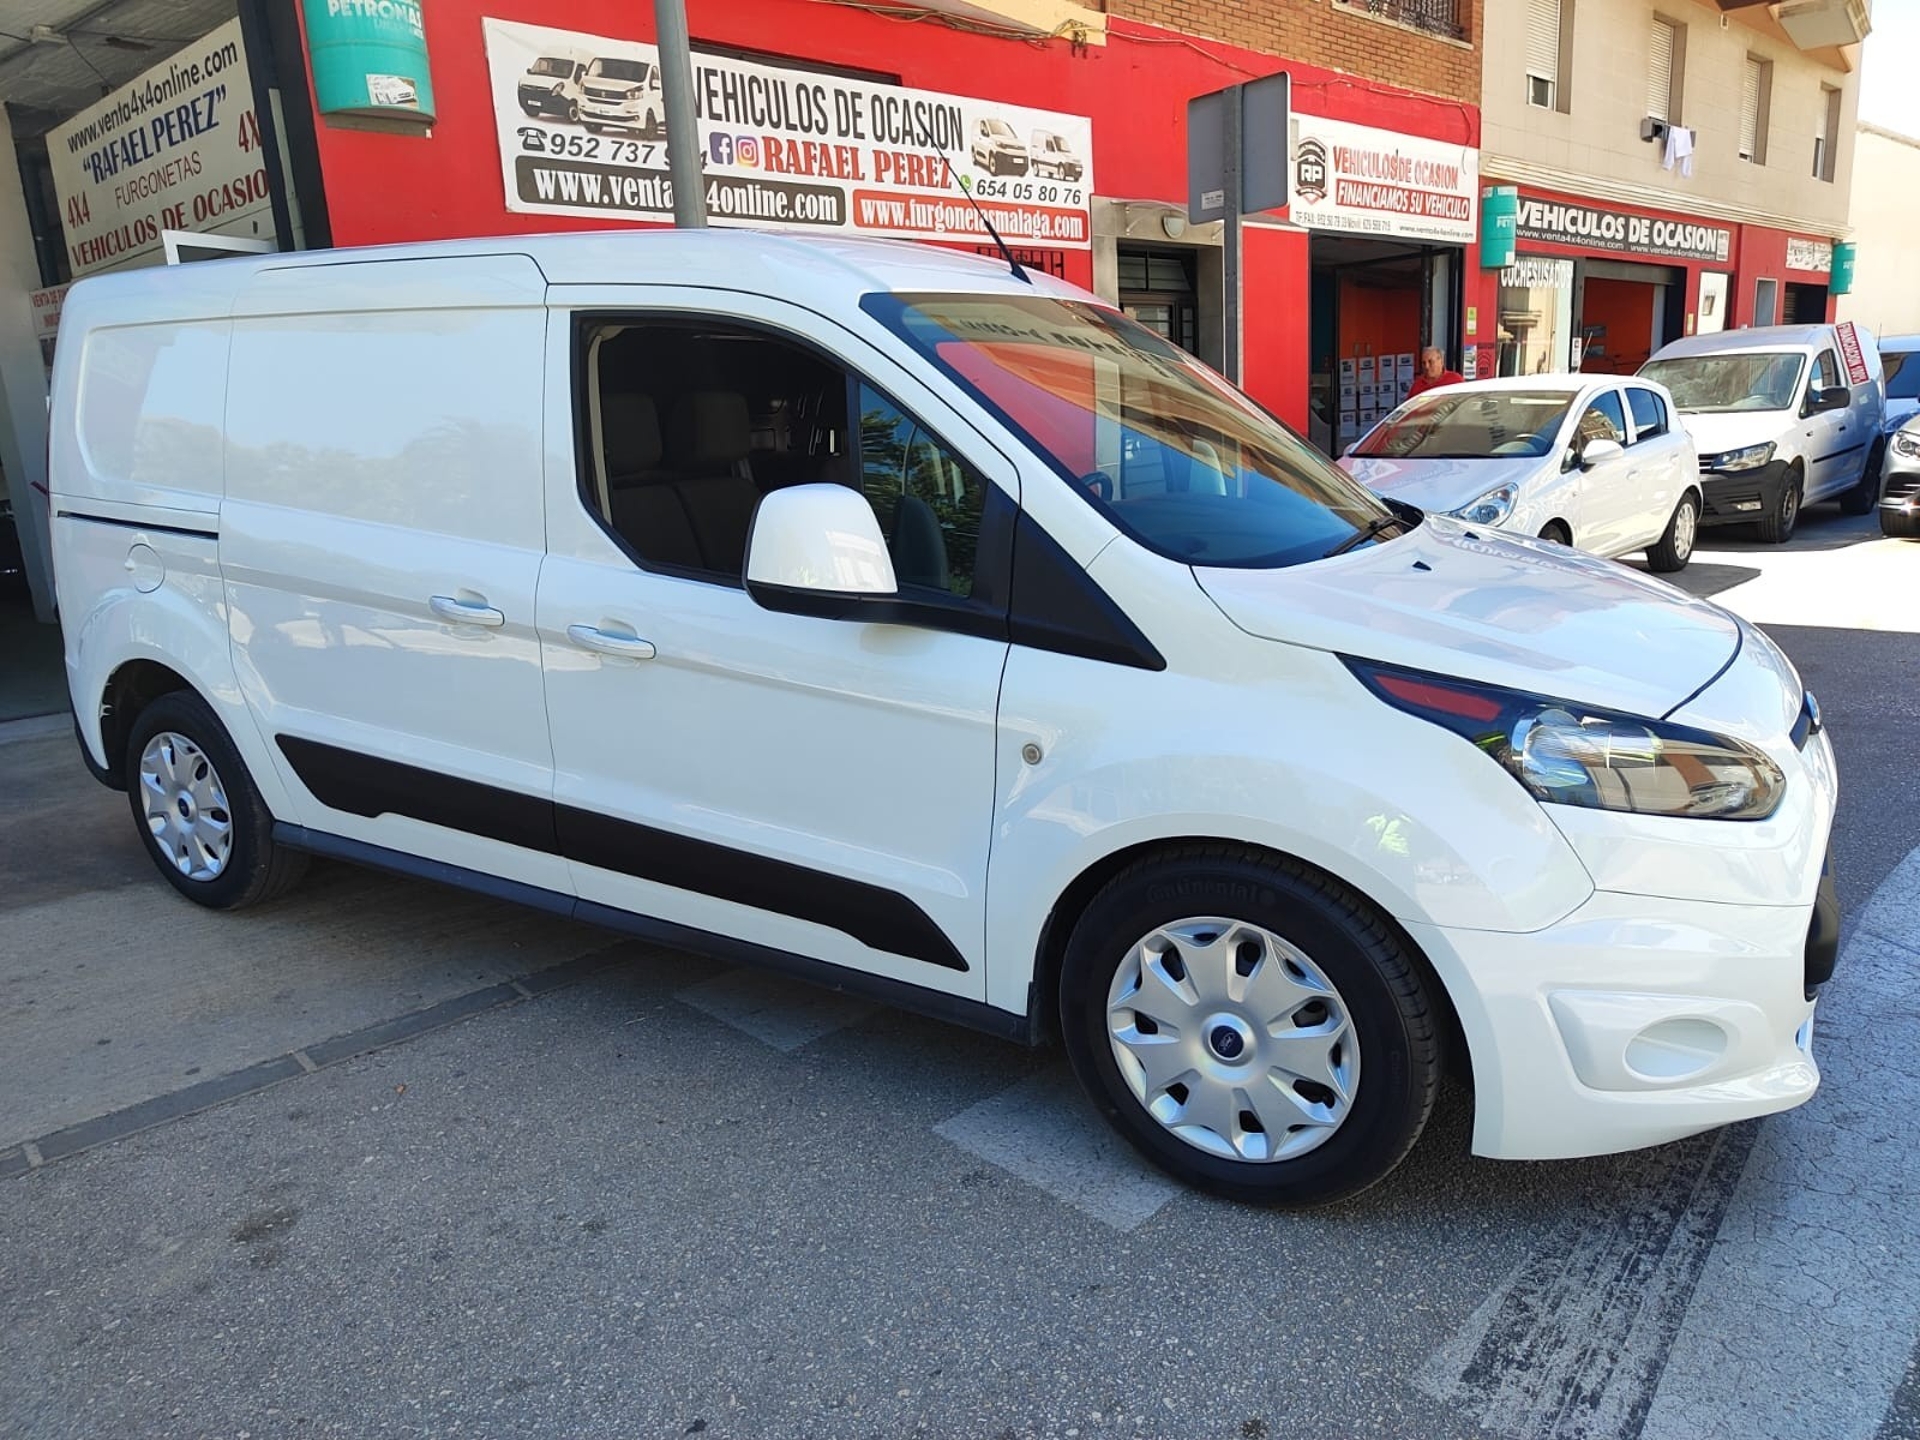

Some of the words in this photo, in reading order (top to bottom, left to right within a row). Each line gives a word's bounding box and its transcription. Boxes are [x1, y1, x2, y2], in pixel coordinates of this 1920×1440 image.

[327, 0, 422, 28] PETRONA
[67, 42, 238, 154] www.venta4x4online.com
[834, 88, 866, 140] DE
[870, 94, 964, 152] OCASION
[238, 110, 263, 153] 4X
[550, 133, 600, 159] 952
[610, 140, 656, 165] 737
[115, 151, 202, 209] FURGONETAS
[762, 136, 866, 181] RAFAEL
[873, 149, 952, 189] PEREZ
[1333, 146, 1397, 179] VEHICULOS
[1398, 156, 1412, 183] DE
[1414, 159, 1459, 190] OCASION
[67, 191, 91, 229] 4X4
[533, 168, 837, 224] www.venta4online.com
[976, 179, 1008, 198] 654
[1013, 184, 1033, 200] 05
[1038, 186, 1057, 203] 80
[1063, 188, 1082, 205] 76
[1338, 182, 1408, 212] FINANCIAMOS
[1410, 191, 1424, 214] SU
[1425, 194, 1469, 220] VEHICULO
[72, 214, 158, 267] VEHICULOS
[162, 202, 189, 231] DE
[193, 169, 269, 222] OCASIO
[1517, 199, 1626, 243] VEHICULOS
[1628, 217, 1650, 245] DE
[1653, 220, 1717, 253] OCASION
[1517, 228, 1625, 250] www.venta4x4online.com
